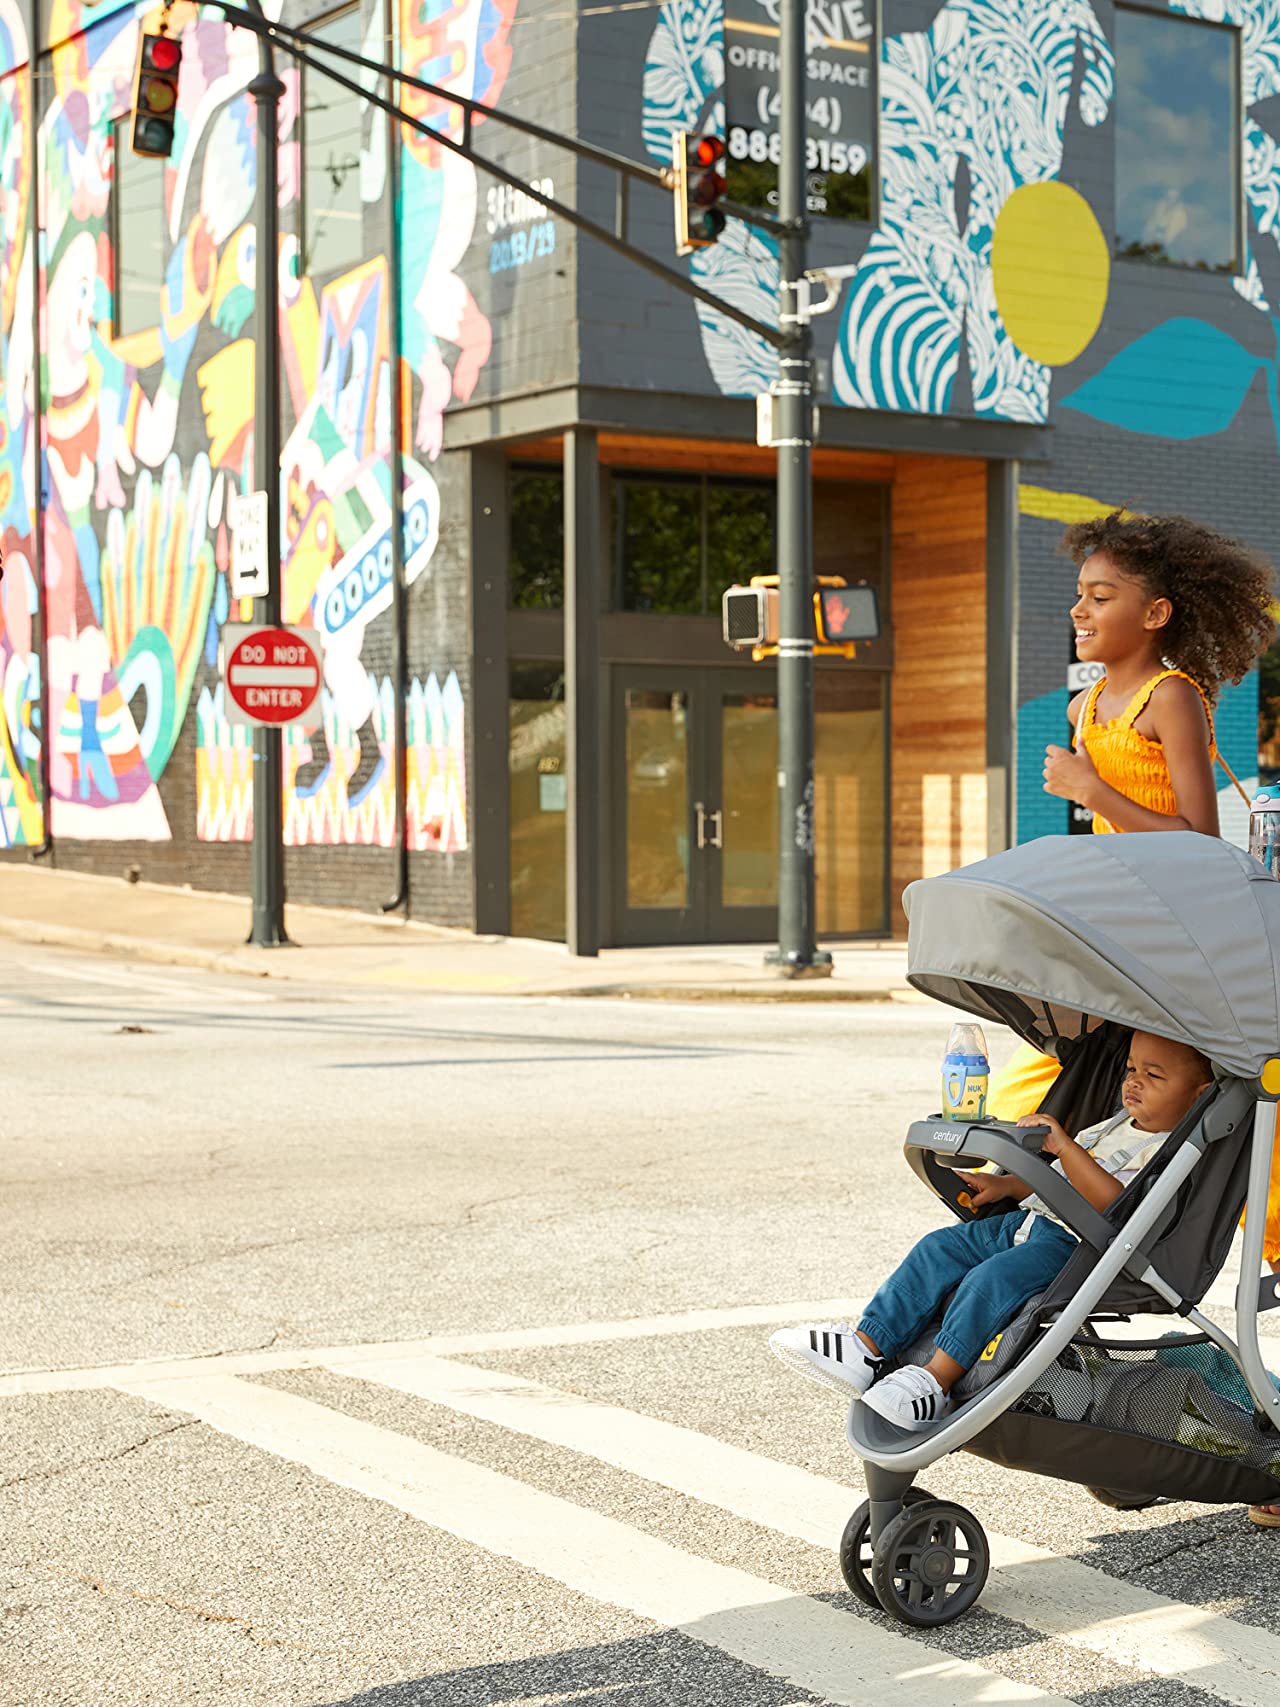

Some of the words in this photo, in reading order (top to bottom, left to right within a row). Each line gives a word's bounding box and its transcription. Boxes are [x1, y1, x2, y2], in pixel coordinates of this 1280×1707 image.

[806, 58, 869, 88] SPACE
[240, 645, 266, 664] DO
[273, 645, 308, 665] NOT
[245, 688, 303, 708] ENTER
[967, 1085, 982, 1093] NUK
[933, 1130, 962, 1145] century
